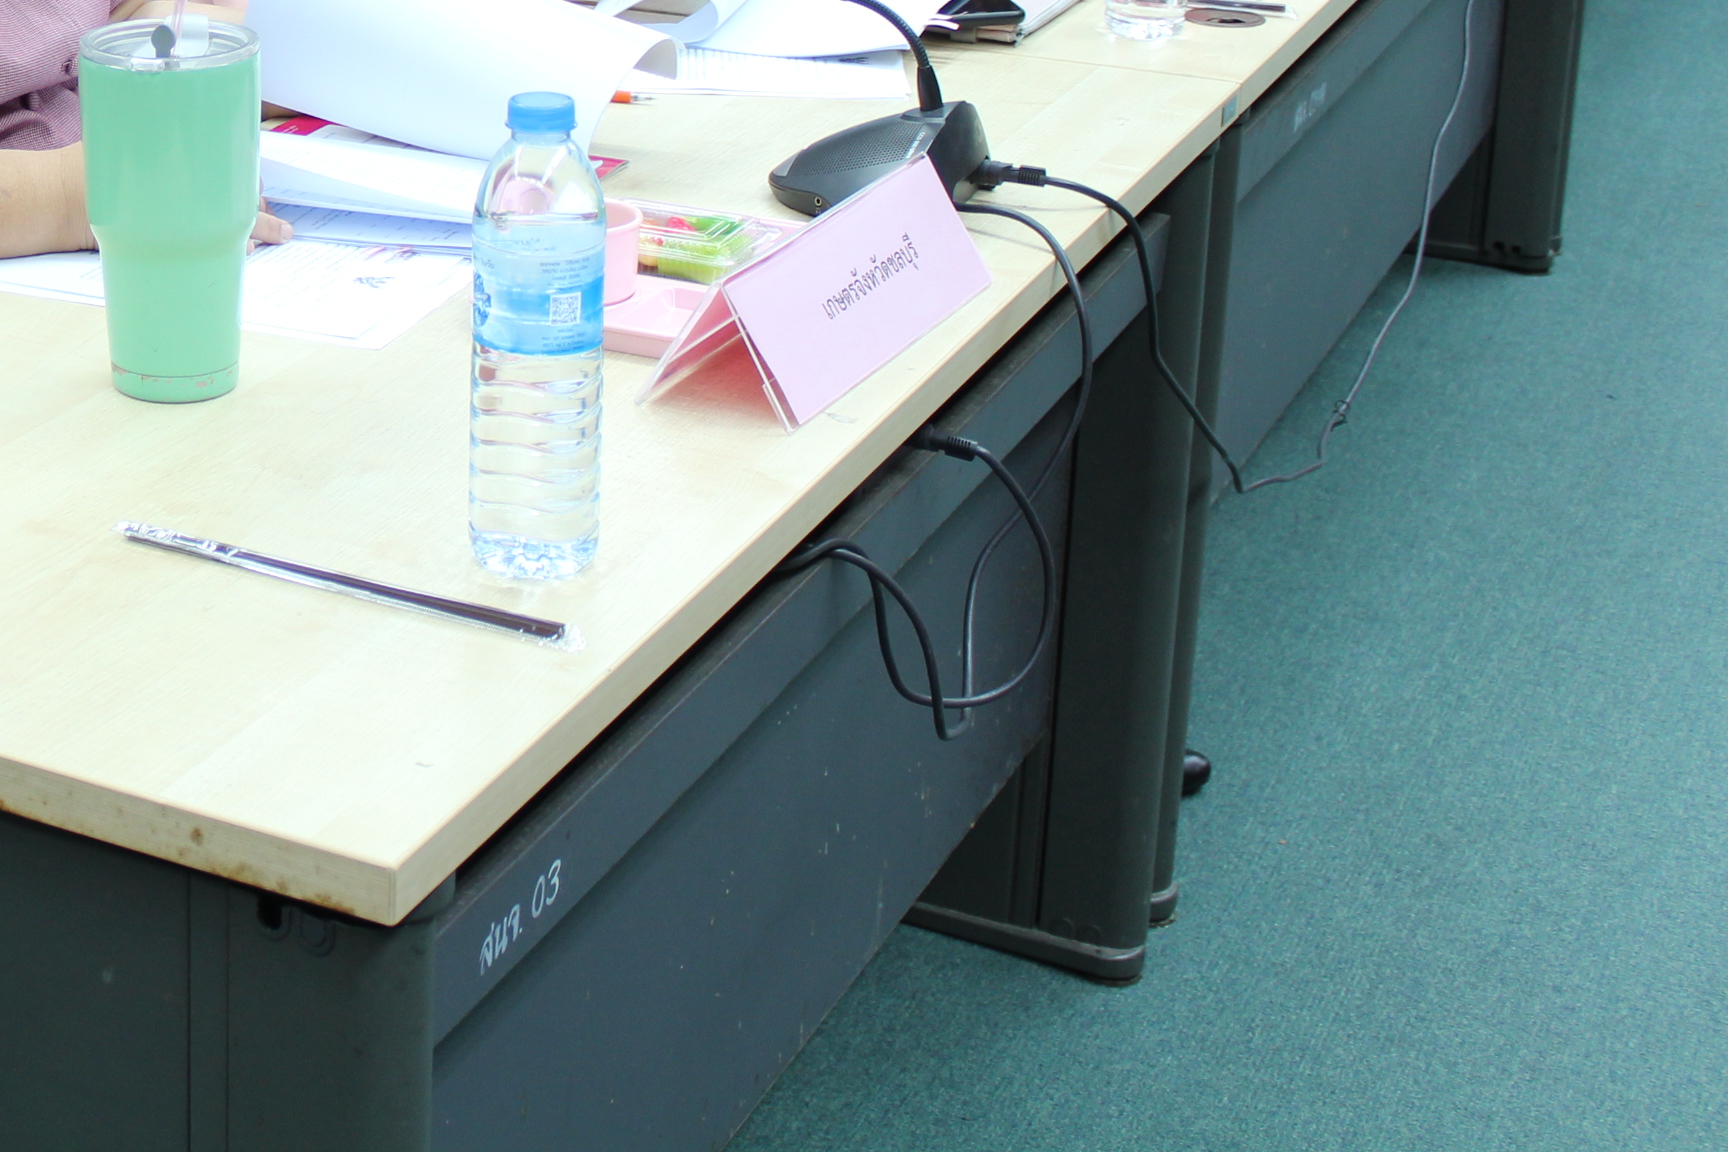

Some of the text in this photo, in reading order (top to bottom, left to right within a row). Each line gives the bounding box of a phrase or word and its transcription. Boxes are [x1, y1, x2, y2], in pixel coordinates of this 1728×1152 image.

[821, 232, 920, 320] เกษตรจังหวัดชลบุรี
[531, 859, 562, 919] 03
